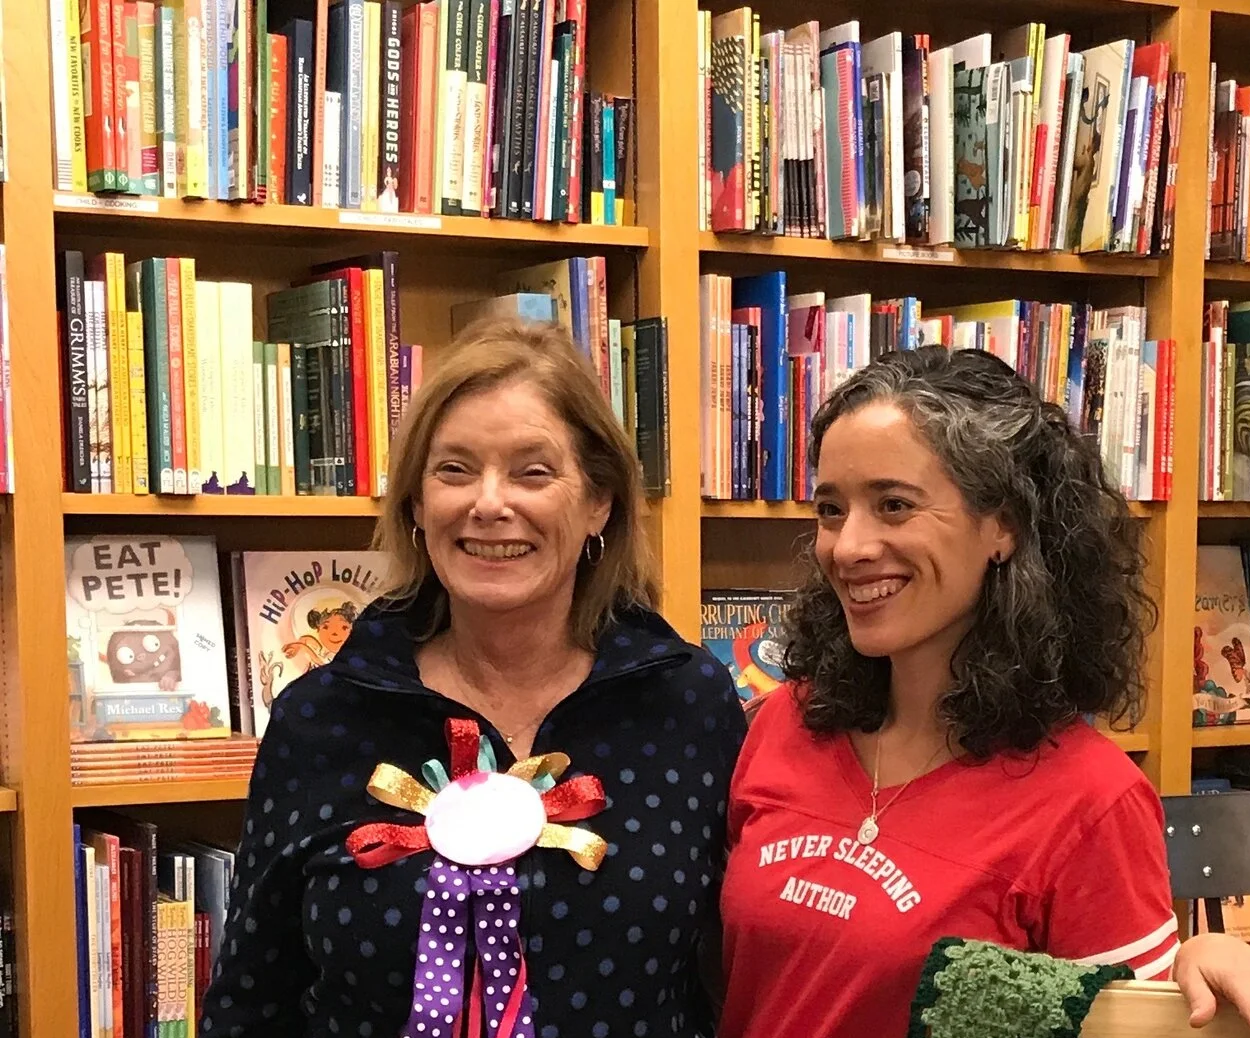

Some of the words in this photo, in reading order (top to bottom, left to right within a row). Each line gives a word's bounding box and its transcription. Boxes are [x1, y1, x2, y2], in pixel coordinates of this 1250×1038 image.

[387, 38, 401, 81] GODS
[386, 98, 399, 162] HEROES
[70, 319, 86, 395] GRIMM'S
[388, 334, 400, 384] ARABIAN
[389, 386, 400, 426] NIGHTS
[93, 541, 161, 570] EAT
[82, 568, 181, 601] PETE!
[700, 628, 749, 639] LEPHANT
[106, 704, 155, 716] Michael
[158, 703, 182, 714] Rex
[759, 835, 833, 867] NEVER
[833, 838, 921, 913] SLEEPING
[780, 877, 857, 920] AUTHOR
[158, 929, 166, 960] HOG
[167, 929, 177, 960] HOG
[177, 929, 187, 960] HOG
[167, 964, 177, 1002] WILD!
[177, 964, 187, 1002] WILD!
